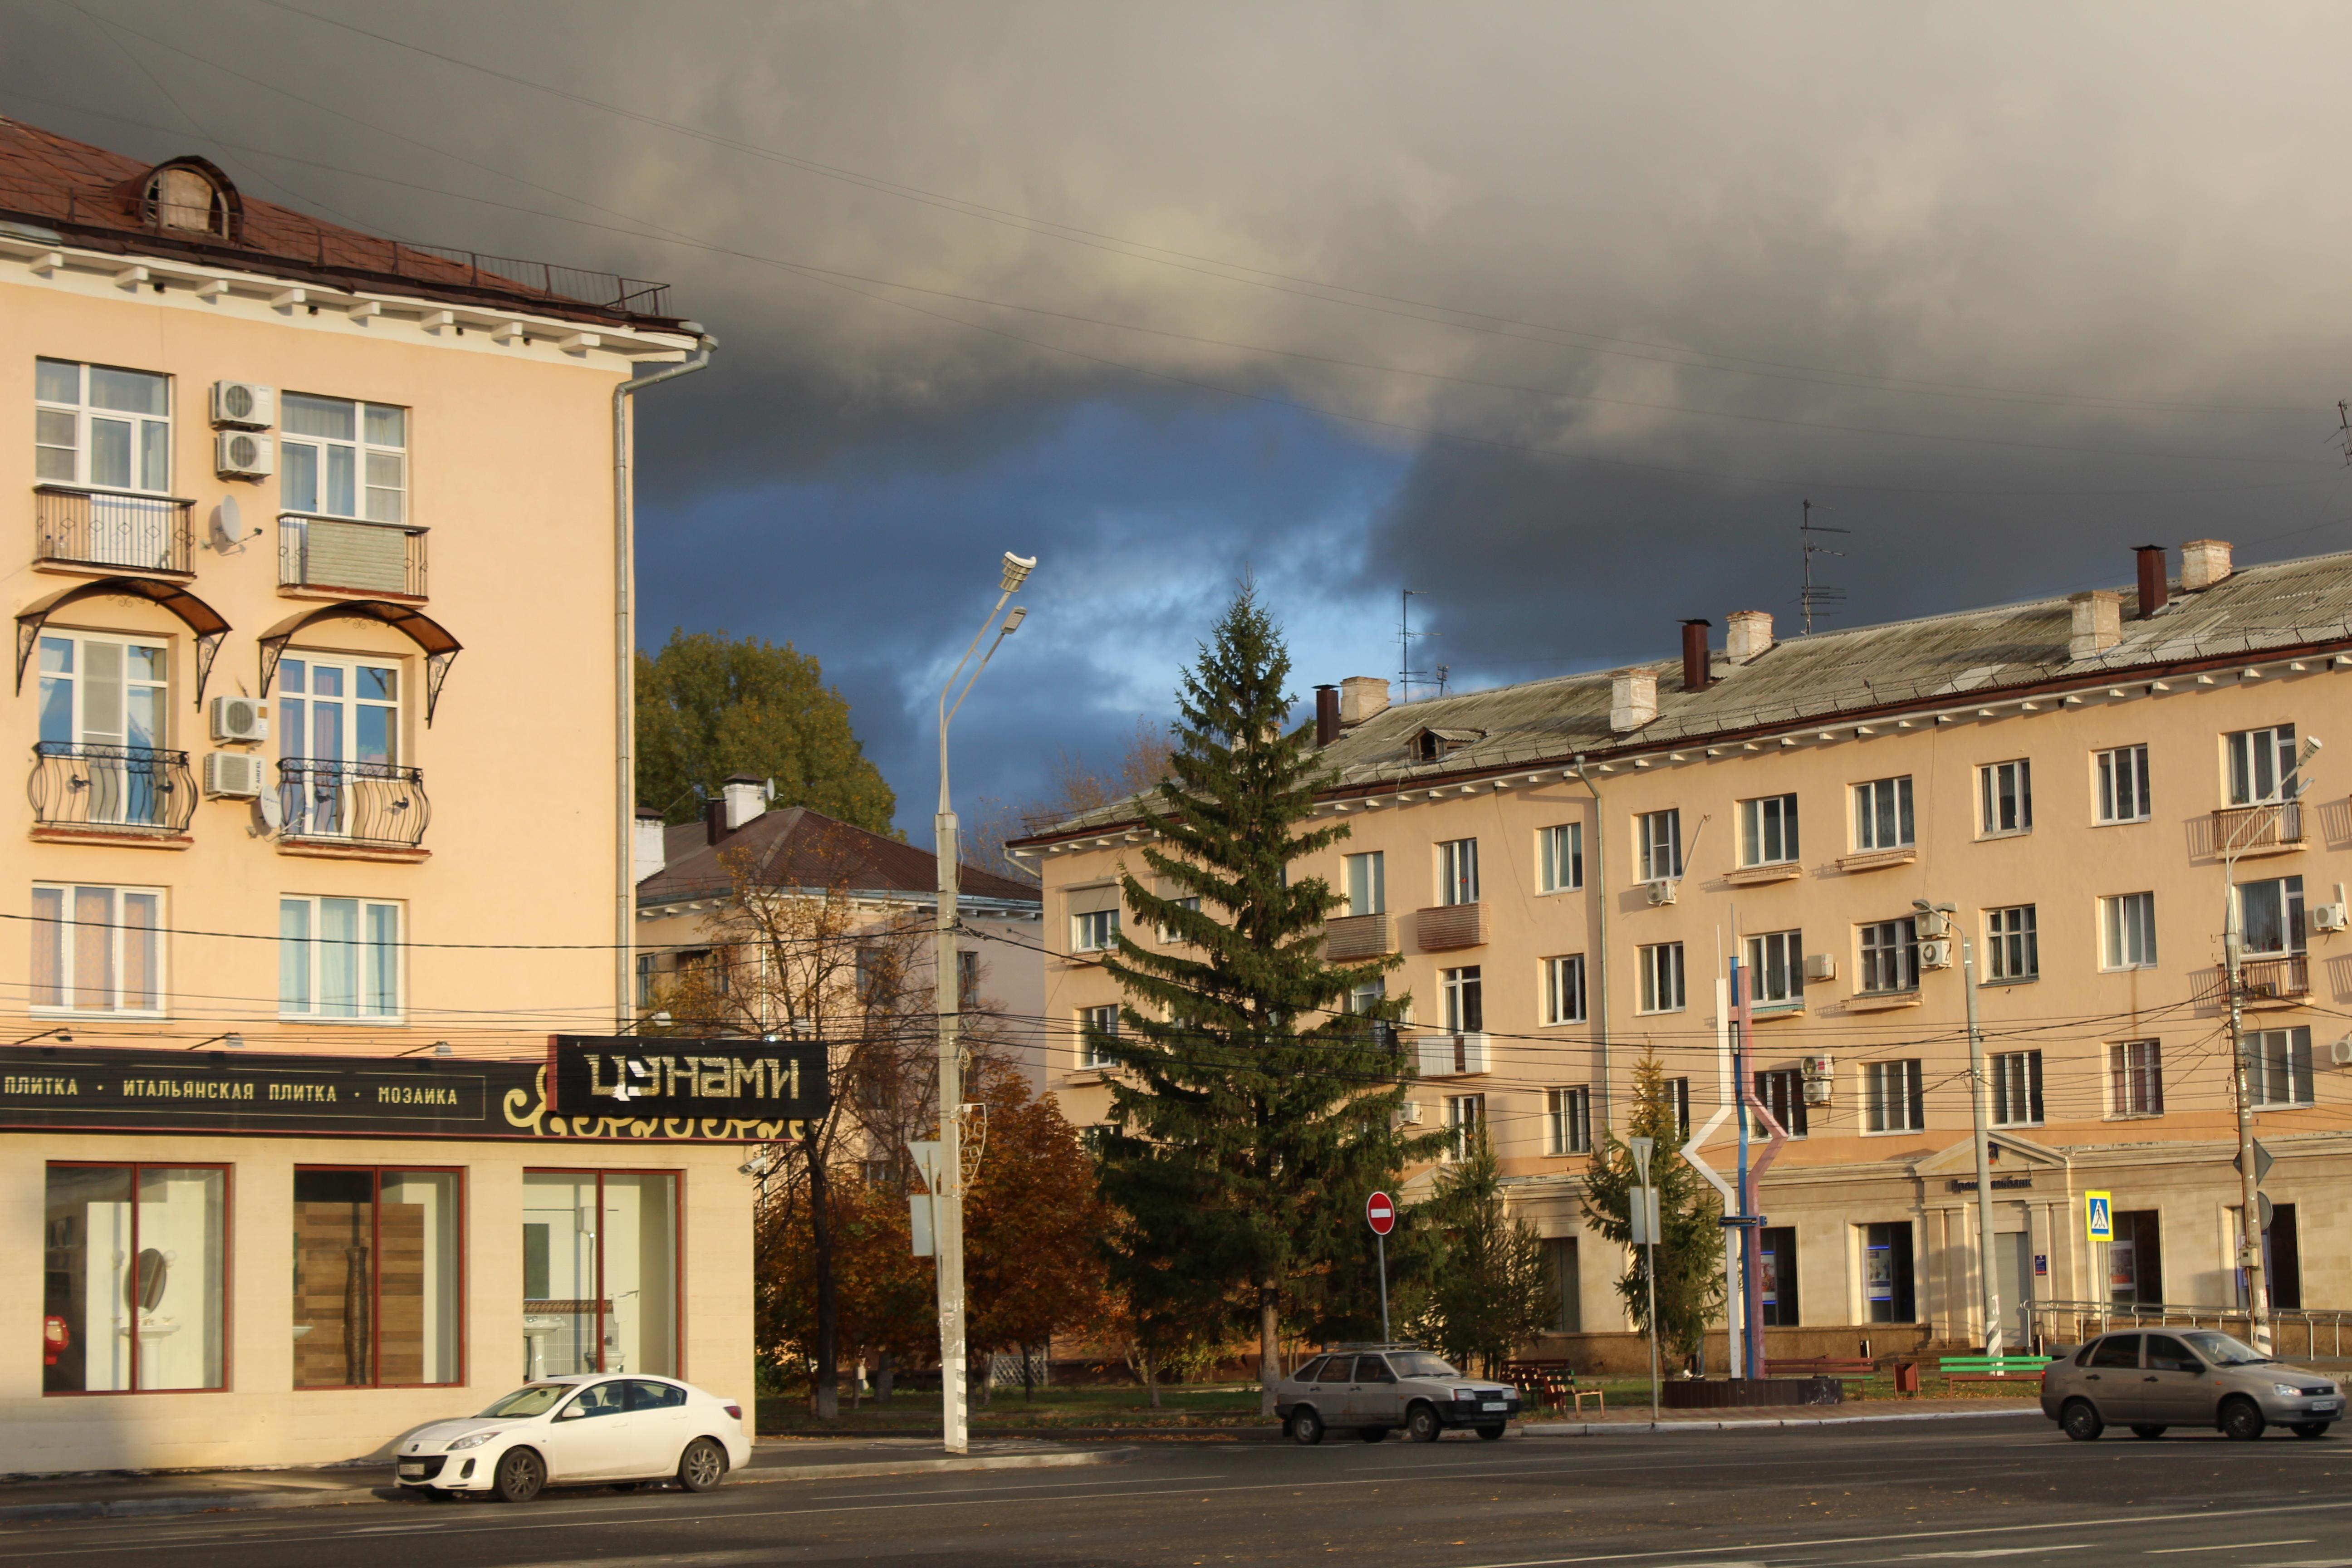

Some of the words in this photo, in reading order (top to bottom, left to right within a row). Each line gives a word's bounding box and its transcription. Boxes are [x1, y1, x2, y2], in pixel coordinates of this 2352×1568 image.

[4, 1076, 78, 1095] ПЛИТКА
[123, 1079, 254, 1100] ИТАЛЬЯНСКАЯ
[269, 1084, 337, 1102] ПЛИТКА
[378, 1087, 457, 1105] МОЗАИКА
[1952, 1176, 2032, 1192] Промязьбанк
